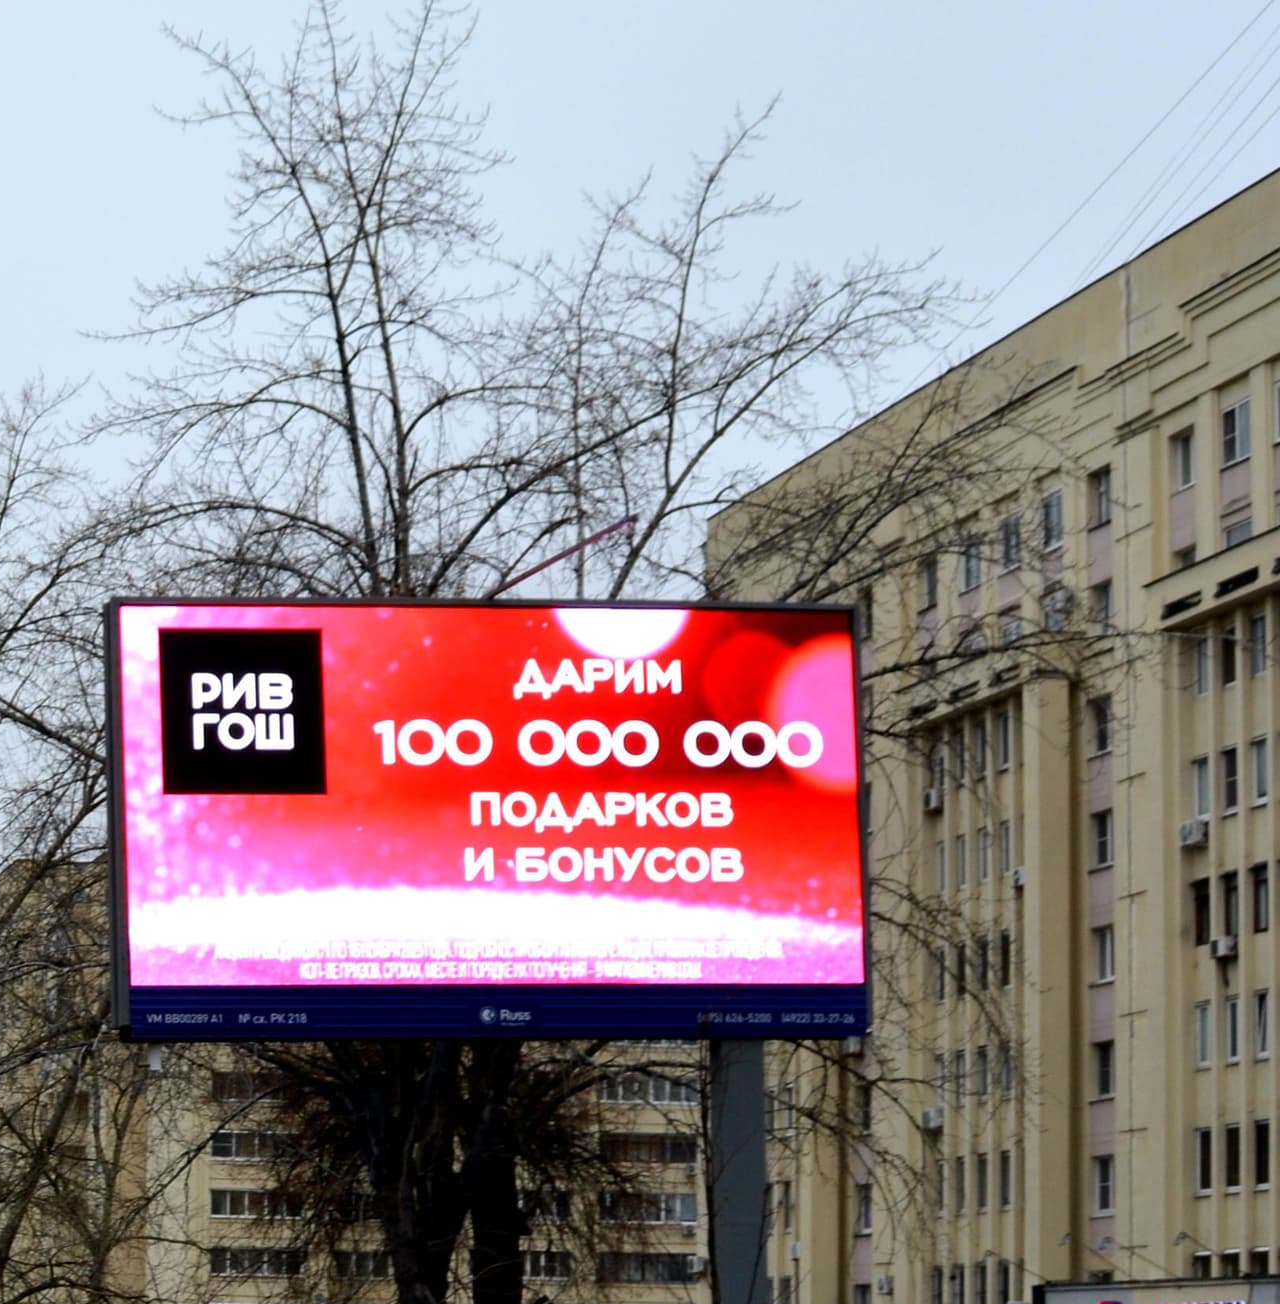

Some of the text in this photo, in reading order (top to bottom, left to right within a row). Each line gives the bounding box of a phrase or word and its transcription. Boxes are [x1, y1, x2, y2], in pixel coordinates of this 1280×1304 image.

[191, 672, 294, 710] РИВ
[513, 658, 683, 700] ДАРИМ
[192, 712, 296, 751] ГОШ
[373, 718, 825, 769] 100 000 000
[469, 790, 734, 834] ПОДАРКОВ
[463, 846, 744, 882] И БОНУСОВ
[499, 1008, 532, 1021] Russ
